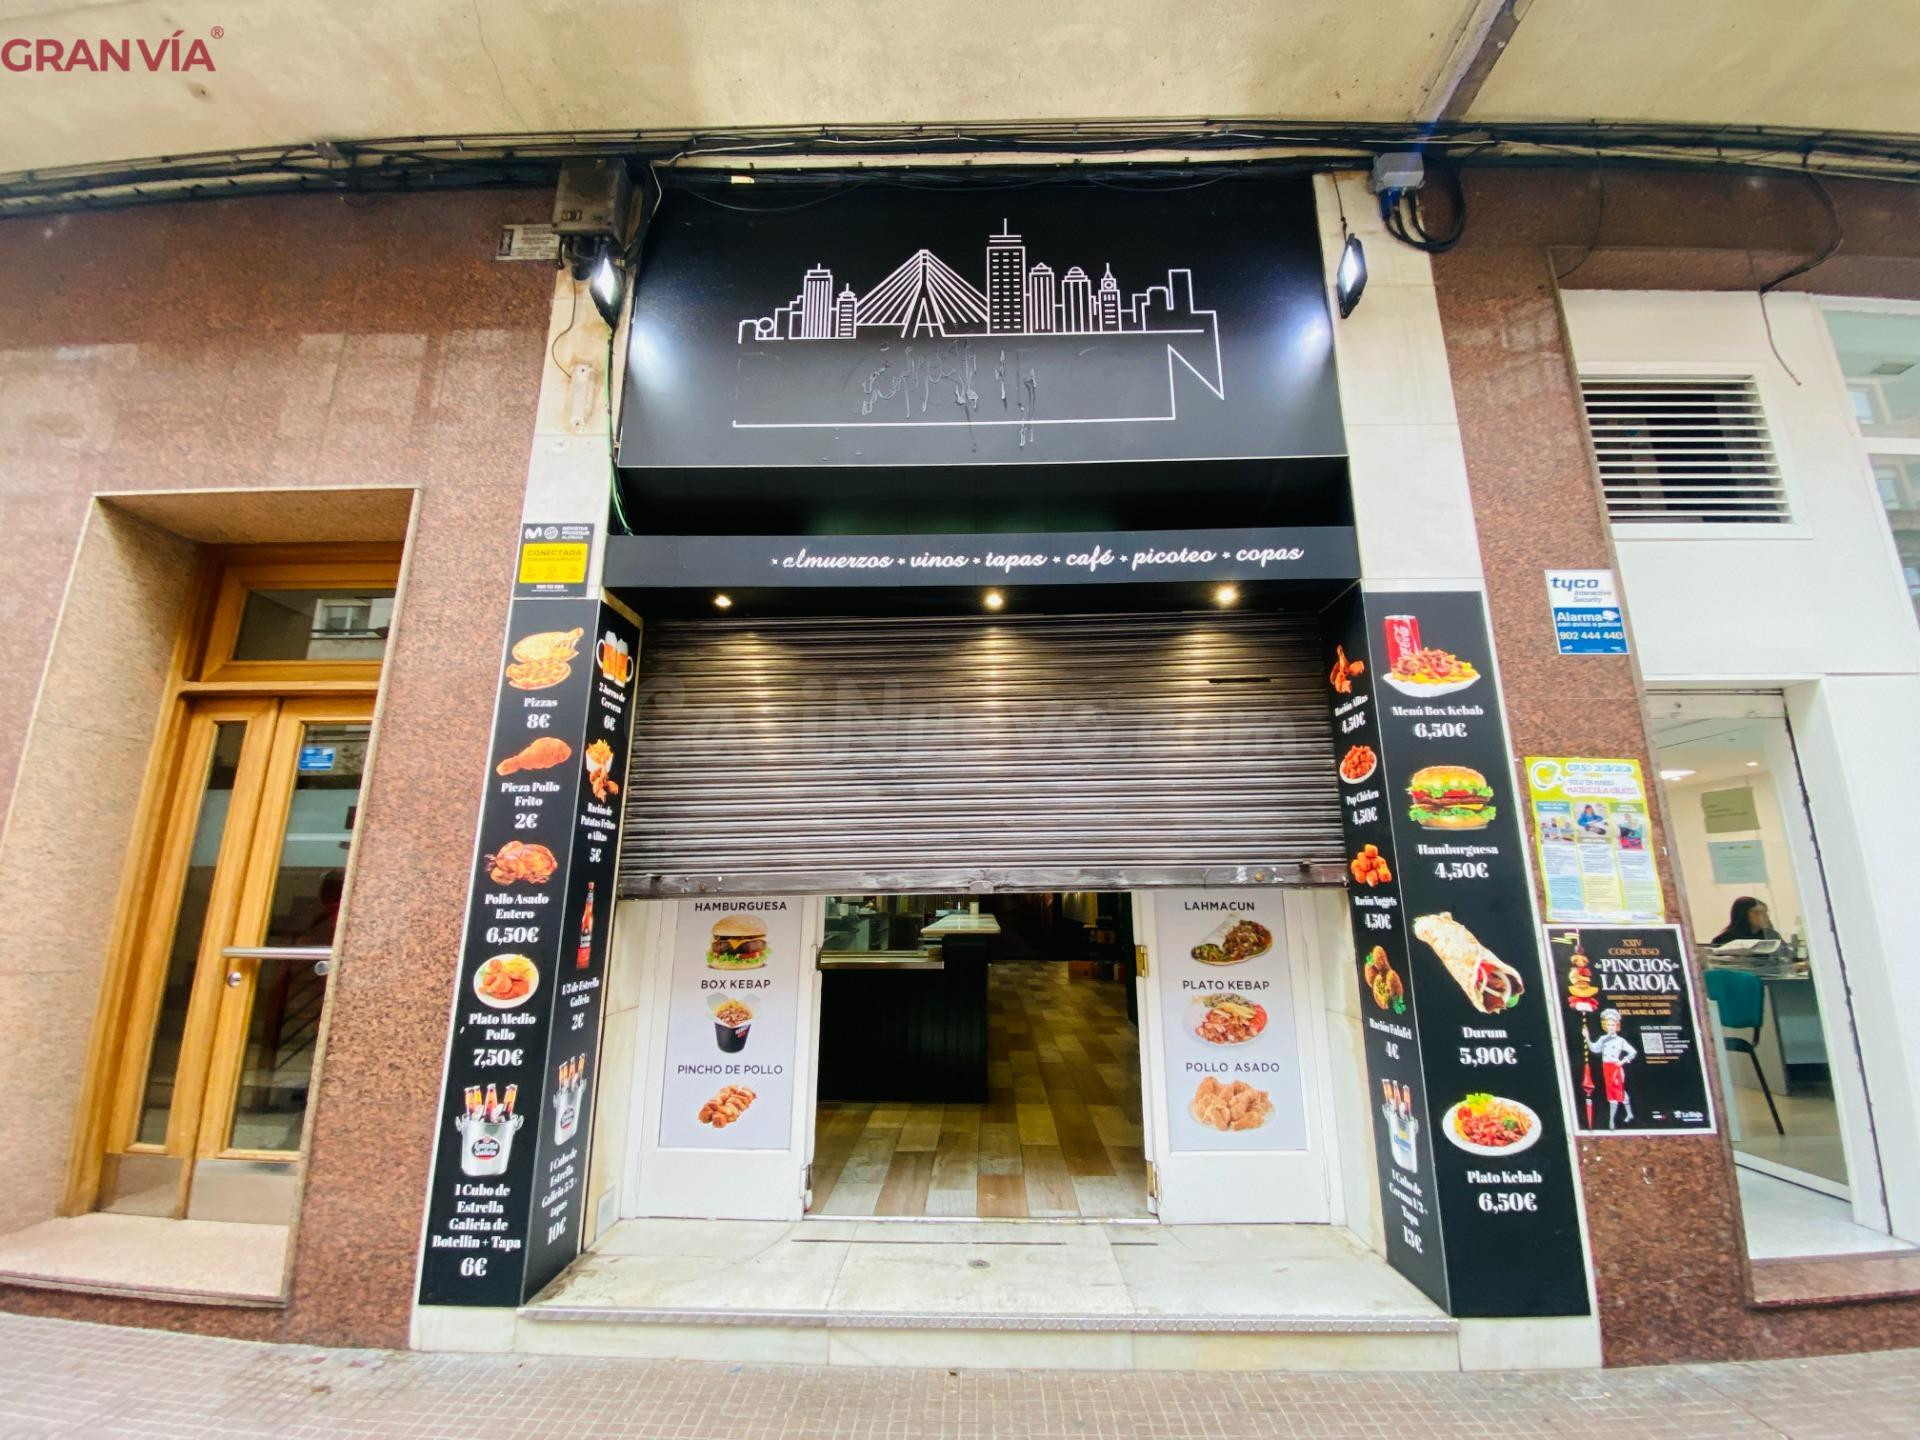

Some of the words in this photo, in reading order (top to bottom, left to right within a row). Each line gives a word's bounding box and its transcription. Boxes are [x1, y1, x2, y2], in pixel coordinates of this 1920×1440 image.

[782, 548, 895, 568] almuerzos
[910, 552, 969, 568] vinos
[984, 551, 1049, 574] tapas
[1065, 545, 1115, 572] café
[1131, 547, 1217, 571] picoteo
[1235, 548, 1305, 568] copas
[1550, 577, 1599, 592] tyco
[1557, 611, 1602, 621] Alarma
[1560, 631, 1579, 640] 902
[1581, 631, 1601, 640] 444
[1603, 631, 1624, 640] 440
[523, 697, 558, 708] Pizzas
[1392, 704, 1423, 717] Menú
[1425, 705, 1446, 717] Box
[1447, 704, 1484, 717] Kebab
[526, 713, 552, 729] 8€
[603, 714, 616, 731] 6€
[1413, 722, 1468, 740] 6,50€
[501, 783, 531, 794] Pieza
[532, 781, 560, 793] Pollo
[514, 796, 543, 807] Frito
[1345, 795, 1357, 807] Pop
[1356, 788, 1380, 804] Chicken
[514, 812, 539, 829] 2€
[580, 814, 601, 828] Patatas
[600, 818, 616, 830] Fritas
[589, 847, 602, 863] 5€
[1417, 843, 1500, 858] Hamburguesa
[1433, 862, 1490, 881] 4,50€
[484, 893, 513, 905] Pollo
[514, 893, 549, 905] Asado
[694, 901, 787, 912] HAMBURGUESA
[1184, 901, 1256, 912] LAHMACUN
[1373, 895, 1398, 910] Nuggets
[495, 909, 535, 920] Entero
[1364, 912, 1393, 931] 4,50€
[485, 926, 539, 945] 6,50€
[1608, 947, 1660, 956] CONCURSO
[1600, 958, 1672, 973] PINCHOS
[700, 979, 726, 990] BOX
[730, 979, 771, 990] KEBAP
[1182, 980, 1225, 990] PLATO
[1228, 980, 1270, 991] KEBAP
[1600, 973, 1627, 991] LA
[1626, 973, 1681, 993] RIOJA
[570, 993, 590, 1008] Galicia
[468, 1013, 499, 1025] Plato
[501, 1013, 536, 1025] Medio
[570, 1012, 585, 1031] 2€
[485, 1028, 516, 1041] Pollo
[1390, 1022, 1412, 1041] Falafel
[1461, 1026, 1508, 1039] Durum
[473, 1048, 524, 1067] 7,50€
[1384, 1041, 1400, 1061] 4€
[1459, 1046, 1519, 1067] 5,90€
[677, 1064, 722, 1075] PINCHO
[725, 1064, 740, 1075] DE
[744, 1064, 783, 1075] POLLO
[1185, 1062, 1229, 1074] POLLO
[1234, 1062, 1280, 1074] ASADO
[1466, 1170, 1500, 1184] Plato
[1502, 1169, 1544, 1184] Kebab
[455, 1183, 462, 1196] 1
[463, 1183, 493, 1196] Cubo
[494, 1183, 511, 1196] de
[457, 1201, 504, 1214] Estrella
[1478, 1191, 1539, 1214] 6,50€
[449, 1218, 491, 1231] Galicia
[493, 1218, 508, 1231] de
[547, 1216, 567, 1246] 10€
[490, 1236, 521, 1252] Tapa
[1402, 1223, 1423, 1254] 13€
[460, 1257, 488, 1277] 6€
